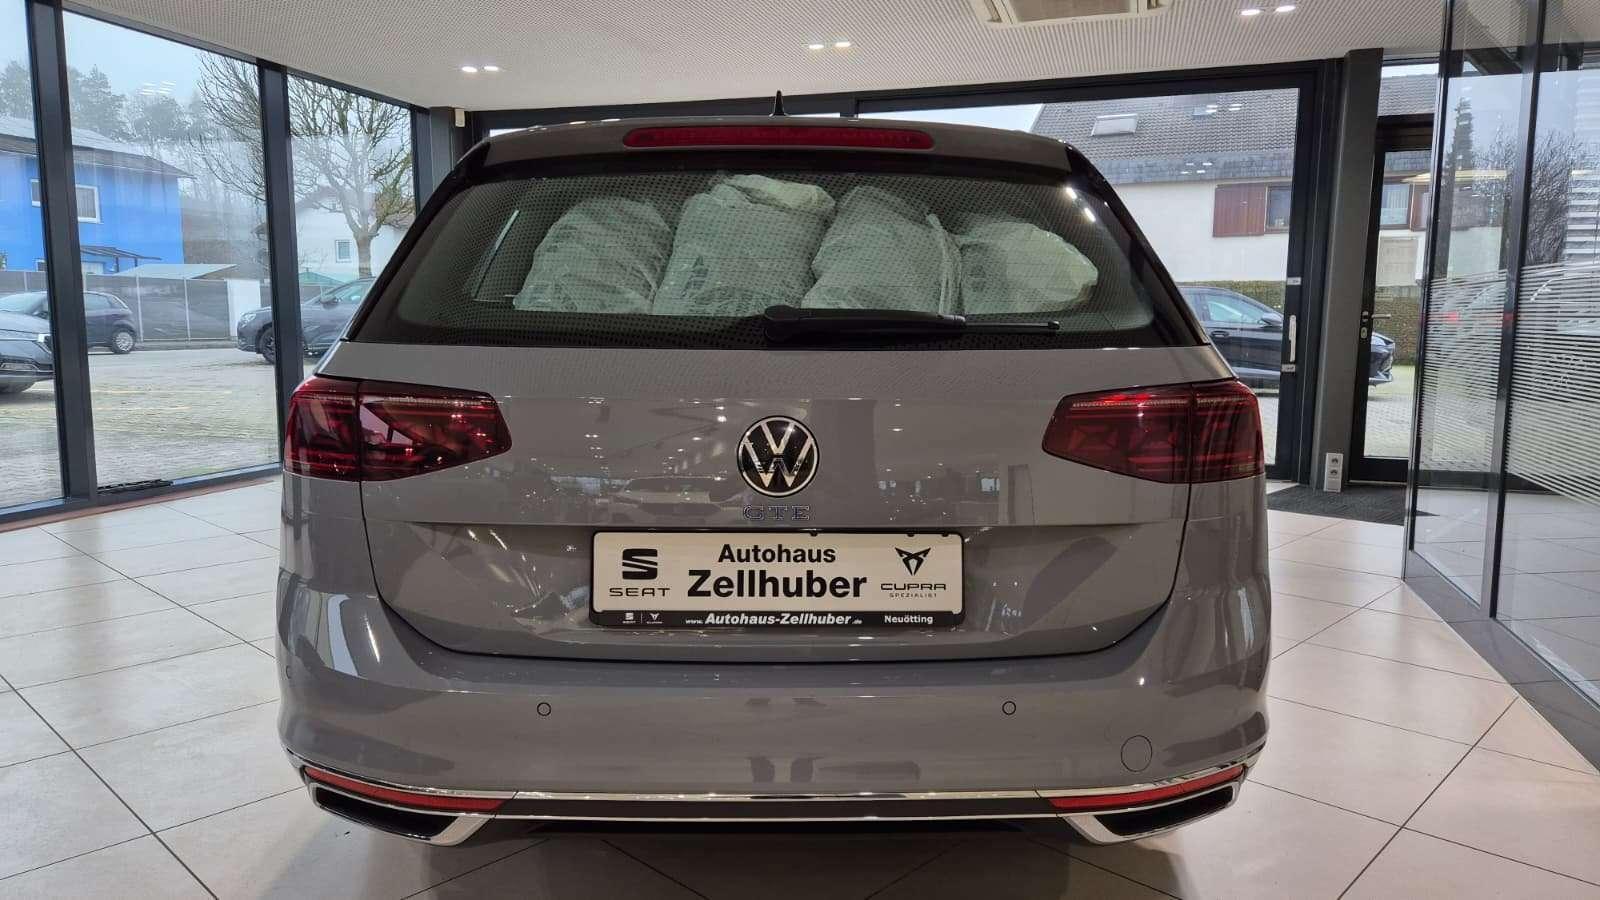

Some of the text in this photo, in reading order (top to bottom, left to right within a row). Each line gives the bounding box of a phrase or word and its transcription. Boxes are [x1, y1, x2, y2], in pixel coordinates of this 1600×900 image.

[743, 505, 810, 520] GTE
[718, 543, 836, 563] Autohaus
[687, 570, 867, 598] Zellhuber
[880, 583, 947, 591] CUPRA
[609, 587, 670, 597] SEAT
[685, 612, 863, 625] www.Autohaus-Zellhuber.de
[884, 614, 934, 625] Neuötting
